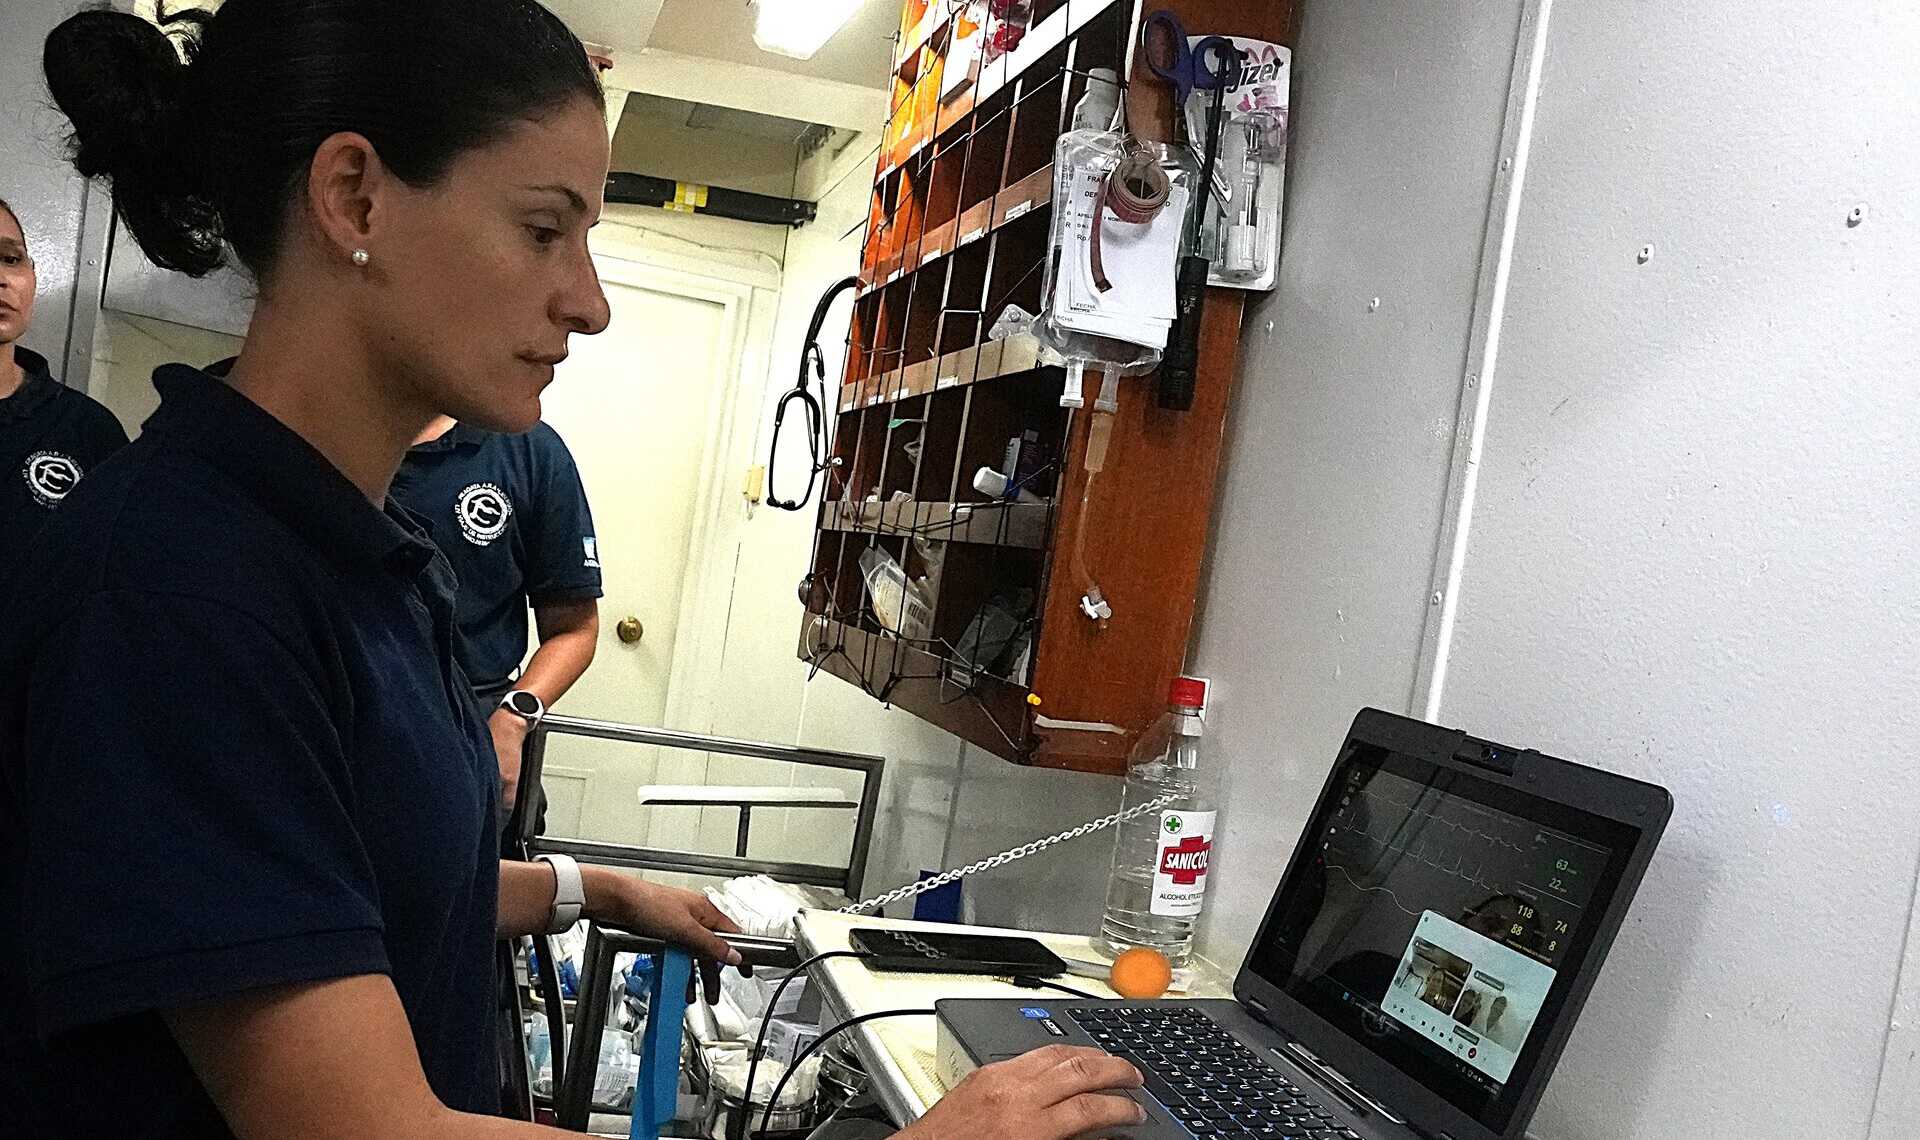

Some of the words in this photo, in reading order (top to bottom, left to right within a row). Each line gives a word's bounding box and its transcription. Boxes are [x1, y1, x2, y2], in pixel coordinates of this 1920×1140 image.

[1165, 850, 1208, 869] SANICOL
[1556, 859, 1568, 871] 63
[1549, 878, 1561, 890] 22
[1160, 893, 1187, 901] ALCOHOL
[1518, 904, 1533, 919] 118
[1511, 923, 1523, 936] 88
[1555, 920, 1568, 934] 74
[1548, 940, 1557, 951] 8
